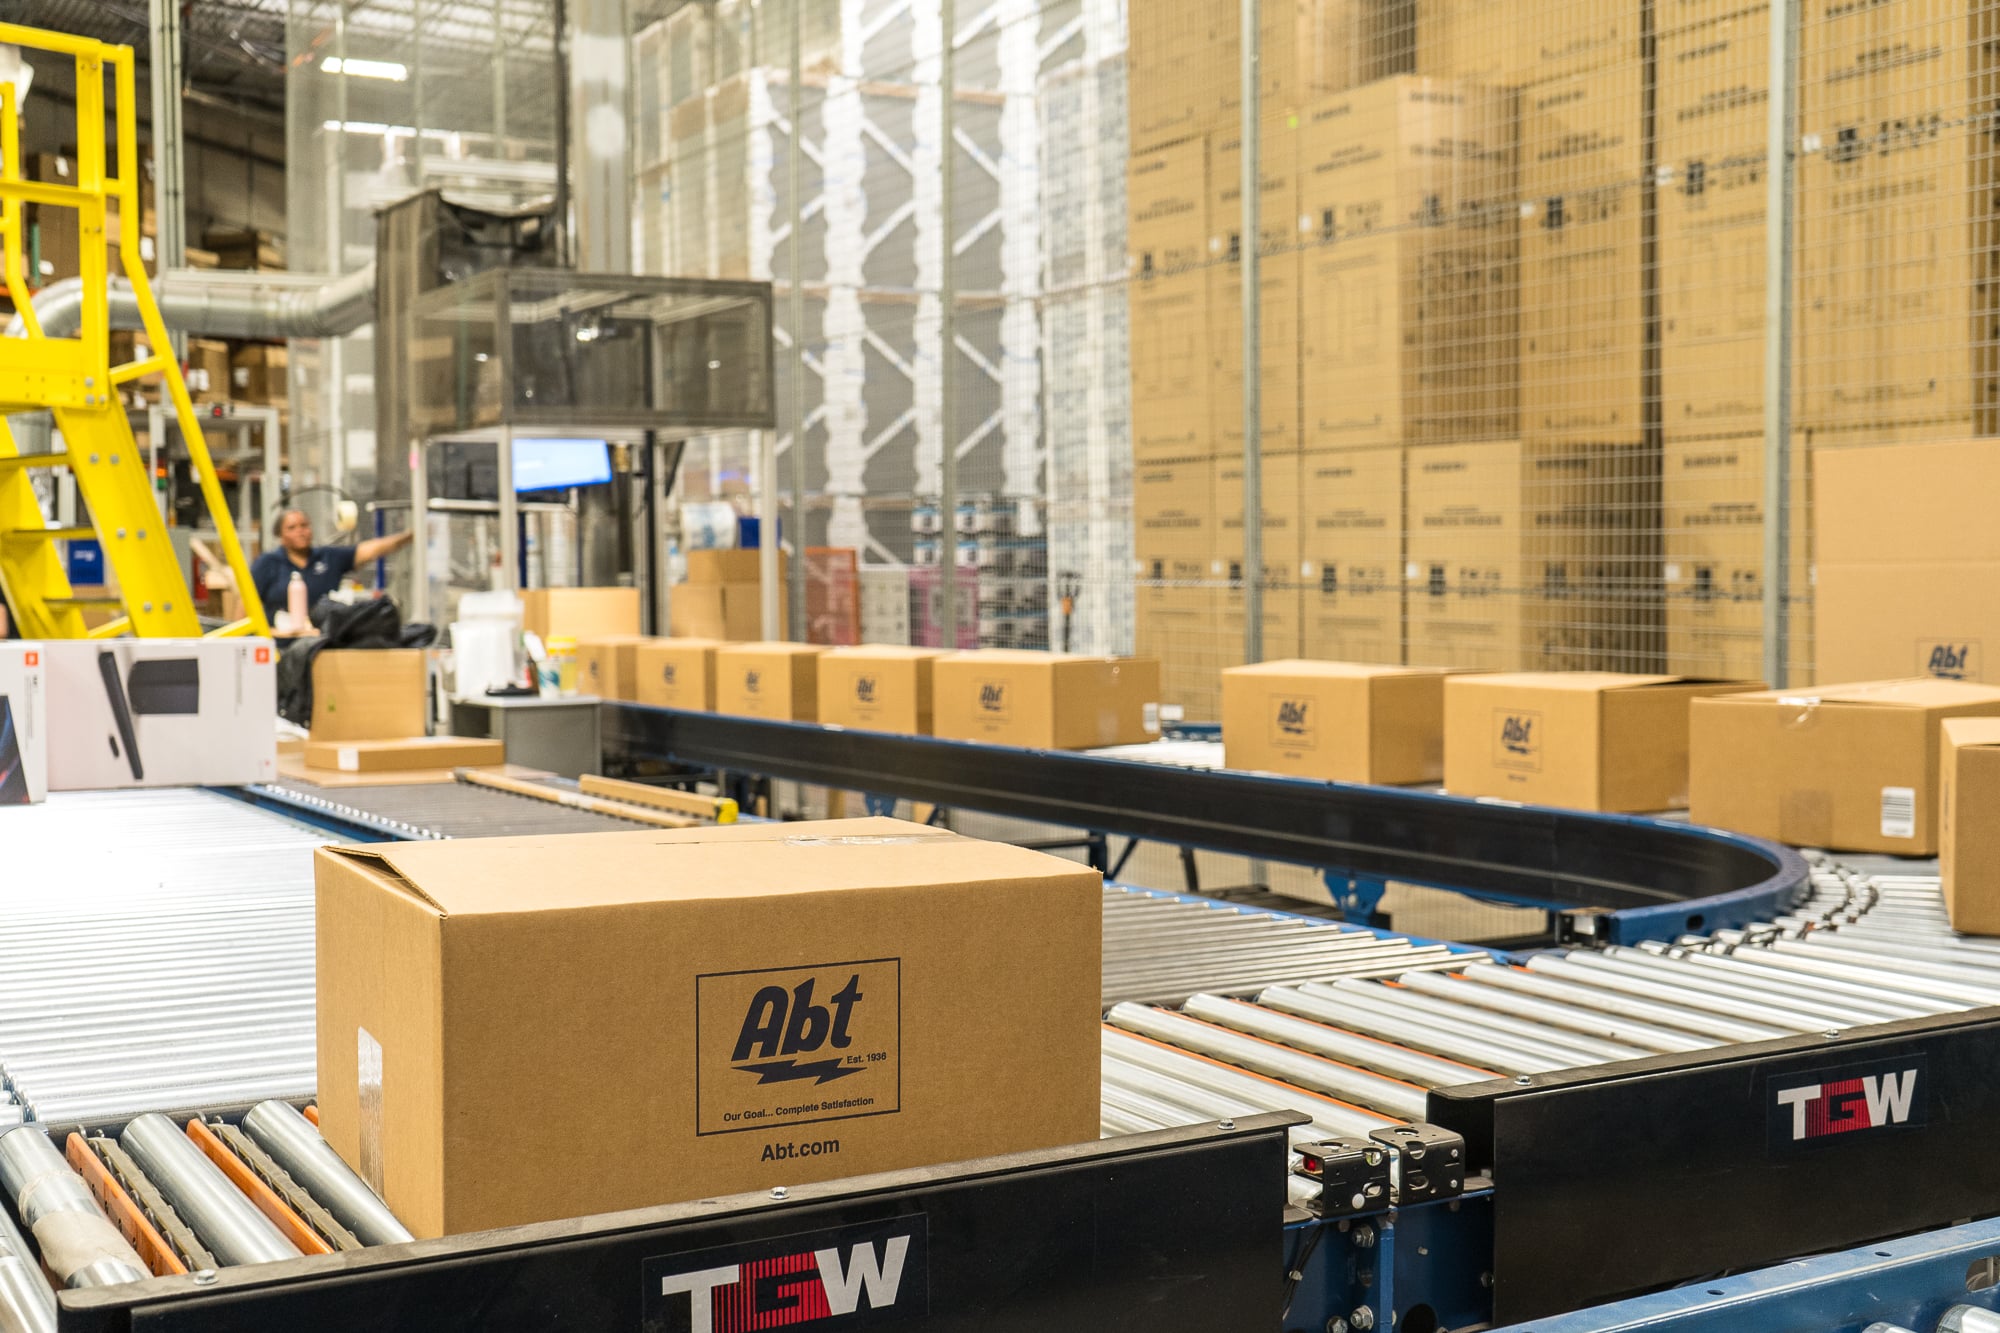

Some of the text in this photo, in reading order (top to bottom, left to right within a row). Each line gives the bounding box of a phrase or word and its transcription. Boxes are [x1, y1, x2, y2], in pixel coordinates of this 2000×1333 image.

[1928, 643, 1968, 669] Abt
[1276, 701, 1308, 721] Abt
[1501, 716, 1532, 741] Abt
[731, 974, 863, 1062] Abt
[846, 1051, 887, 1065] Est. 1936
[723, 1096, 874, 1122] Our Goal... Complete Satisfaction
[1778, 1069, 1917, 1141] TGW
[761, 1138, 840, 1162] Abt.com
[662, 1234, 910, 1333] TGW
